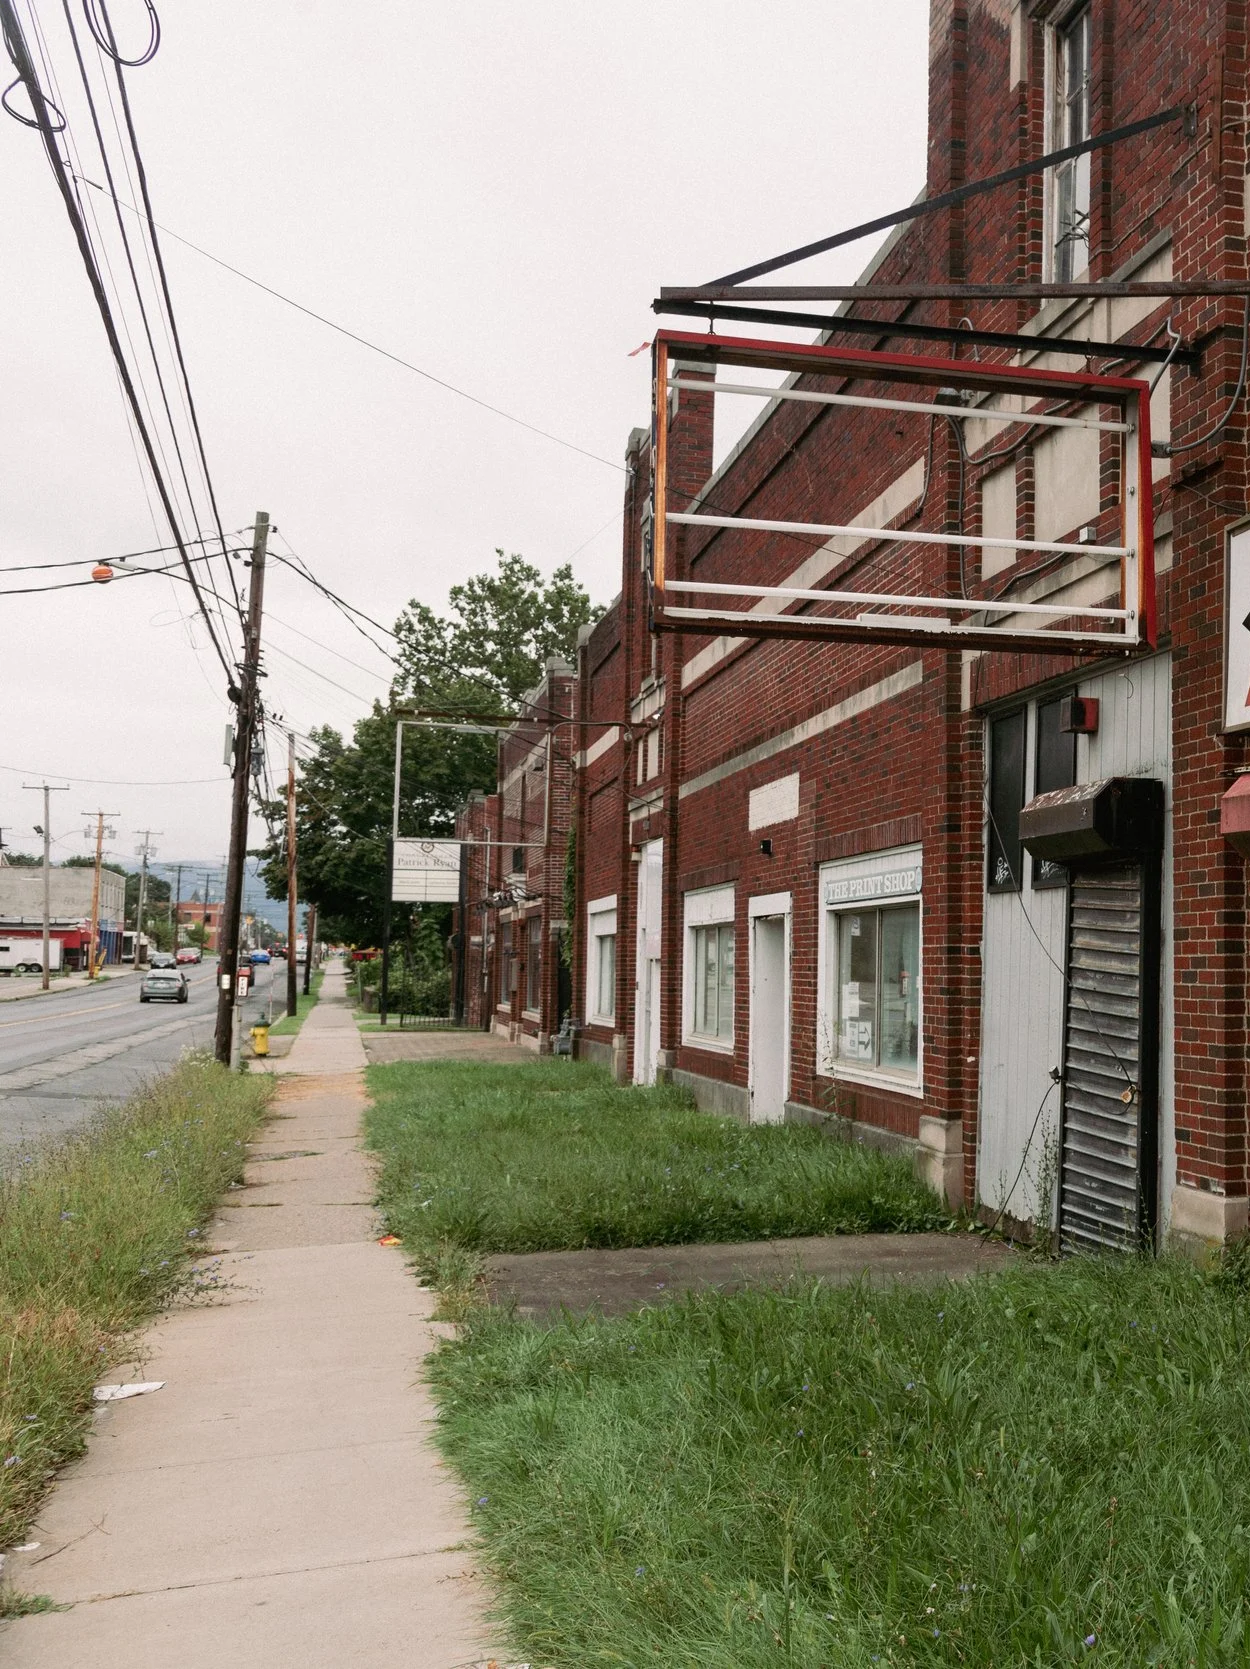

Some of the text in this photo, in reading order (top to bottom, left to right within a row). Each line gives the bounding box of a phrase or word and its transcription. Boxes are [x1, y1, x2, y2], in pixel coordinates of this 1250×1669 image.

[398, 858, 457, 868] Patrick Ryan
[828, 871, 915, 900] THE PRINT SHOP
